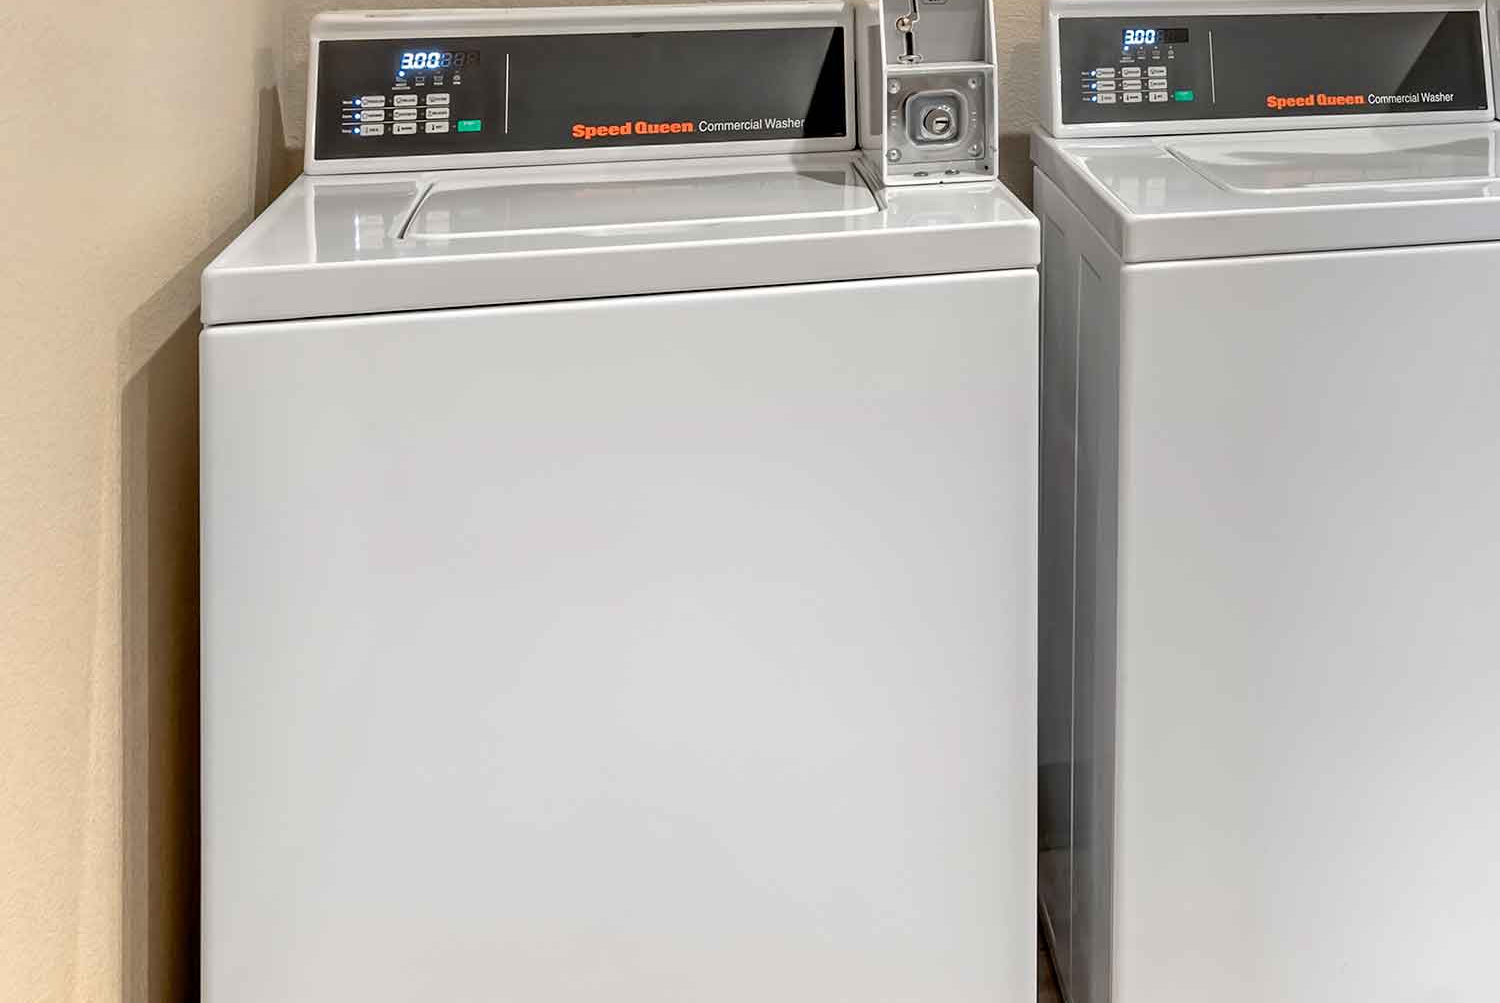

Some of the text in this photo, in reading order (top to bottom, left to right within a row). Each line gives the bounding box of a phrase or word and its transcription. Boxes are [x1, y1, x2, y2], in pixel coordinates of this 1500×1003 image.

[1124, 29, 1156, 45] 3.00
[1266, 92, 1454, 110] Speed Queen Commercial Washer
[572, 117, 805, 140] Speed Queen Commercial Washer
